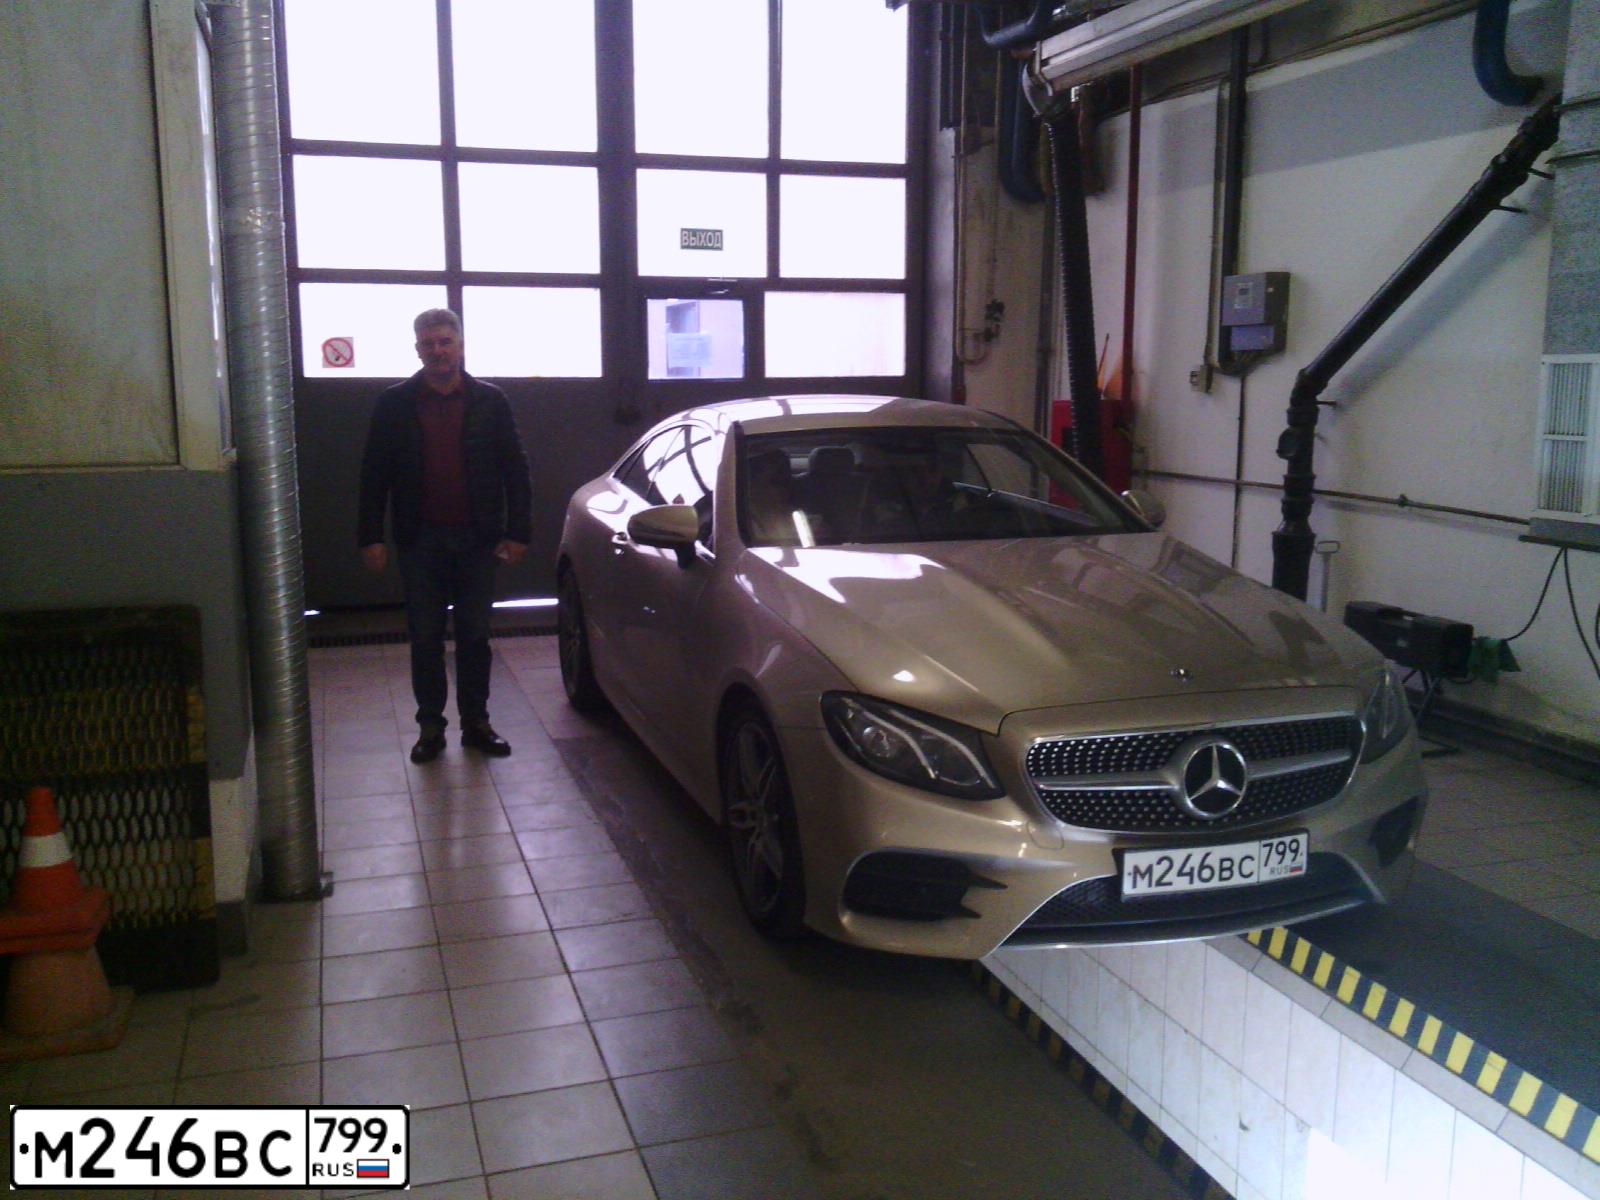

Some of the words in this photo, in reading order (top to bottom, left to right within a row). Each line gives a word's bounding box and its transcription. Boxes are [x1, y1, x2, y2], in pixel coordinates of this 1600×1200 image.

[682, 230, 722, 249] ВЫХОД
[1262, 838, 1300, 867] 799
[1132, 852, 1255, 889] М246ВС
[1270, 865, 1290, 876] RUS
